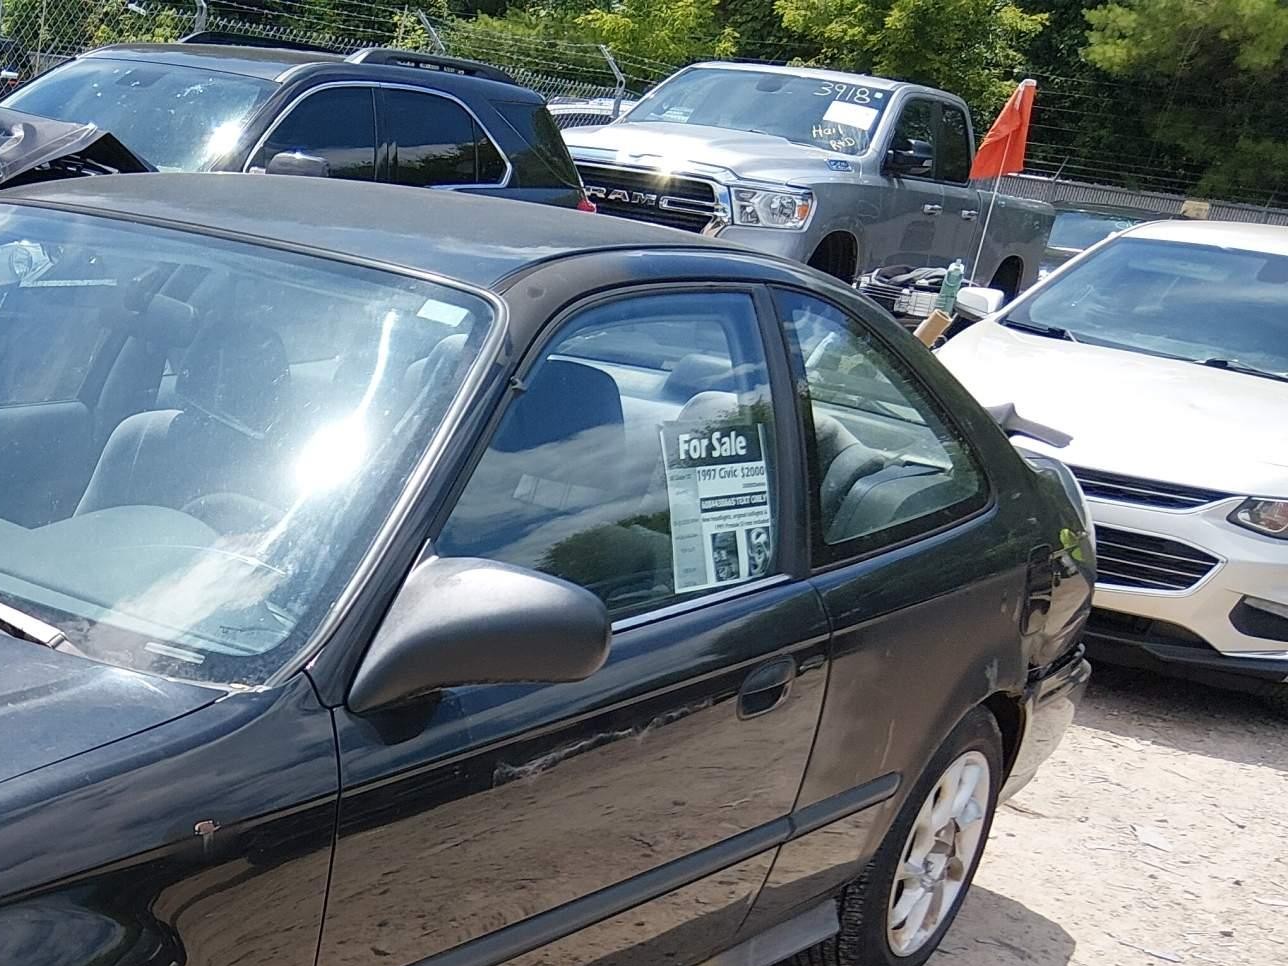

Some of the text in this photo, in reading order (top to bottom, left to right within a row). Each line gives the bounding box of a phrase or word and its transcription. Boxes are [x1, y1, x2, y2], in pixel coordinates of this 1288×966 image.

[813, 81, 871, 104] 3918
[812, 124, 844, 139] Hail
[584, 184, 657, 206] RAM
[679, 430, 747, 460] For Sale
[697, 468, 716, 482] 1997
[718, 466, 738, 479] Civic
[740, 465, 765, 478] $2000
